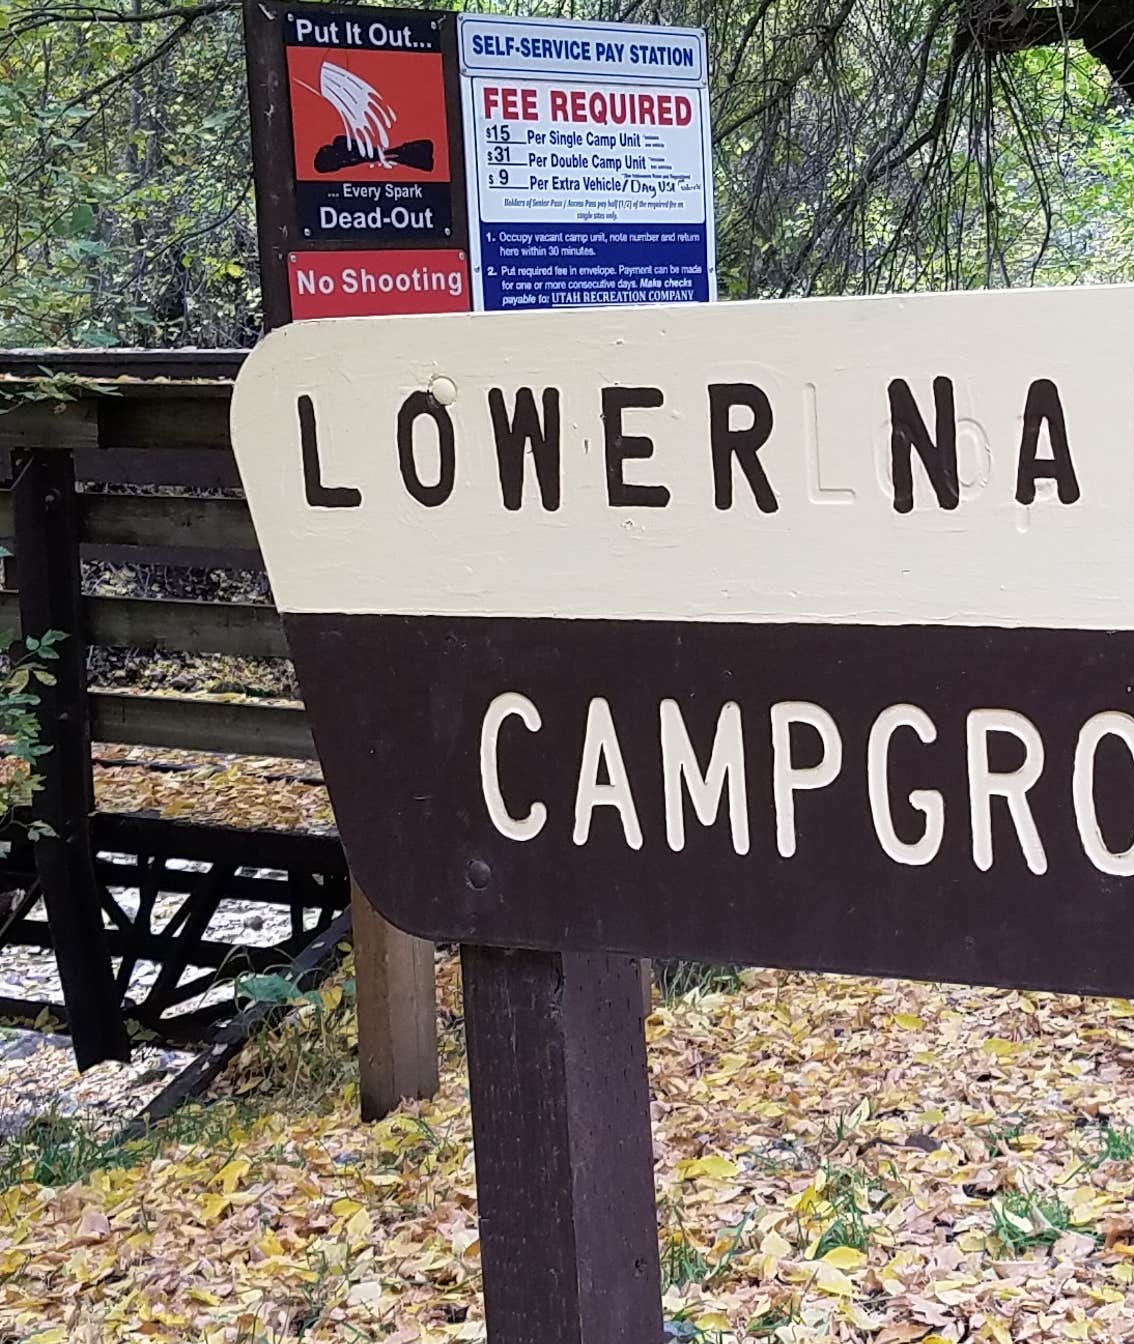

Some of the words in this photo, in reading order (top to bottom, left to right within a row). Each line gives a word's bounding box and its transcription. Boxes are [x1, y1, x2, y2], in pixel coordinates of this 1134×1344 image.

[296, 18, 339, 44] Put
[346, 21, 363, 46] It
[368, 23, 432, 49] Out...
[472, 34, 590, 61] SELF-SERVICE
[596, 42, 624, 63] PAY
[630, 44, 694, 67] STATION
[483, 87, 538, 121] FEE
[550, 90, 692, 126] REQUIRED
[527, 130, 546, 144] Per
[549, 131, 583, 148] Single
[586, 132, 616, 149] Camp
[619, 133, 641, 147] Unit
[528, 153, 547, 167] Per
[551, 153, 588, 168] Double
[592, 154, 622, 172] Camp
[625, 155, 646, 169] Unit
[343, 183, 383, 200] Every
[385, 184, 423, 201] Spark
[530, 176, 548, 190] Per
[552, 176, 580, 191] Extra
[320, 206, 434, 230] Dead-Out
[499, 232, 532, 244] Occupy
[534, 233, 563, 242] vacant
[565, 234, 588, 244] camp
[609, 233, 627, 242] note
[629, 233, 659, 242] number
[661, 233, 675, 242] and
[677, 233, 700, 242] return
[500, 246, 519, 256] here
[521, 246, 547, 256] within
[548, 246, 559, 256] 30
[501, 266, 516, 276] Put
[518, 266, 553, 277] required
[555, 266, 567, 275] fee
[619, 265, 652, 277] Payment
[654, 266, 668, 274] can
[669, 265, 679, 274] be
[681, 265, 702, 274] made
[296, 270, 334, 295] No
[341, 266, 463, 296] Shooting
[502, 280, 514, 290] for
[516, 281, 532, 290] one
[545, 281, 566, 289] more
[568, 279, 615, 290] consecutive
[640, 278, 662, 288] Make
[664, 278, 692, 287] checks
[502, 294, 536, 306] payable
[551, 292, 580, 303] UTAH
[583, 291, 646, 303] RECREATION
[648, 290, 694, 301] COMPANY
[298, 383, 778, 513] LOWER
